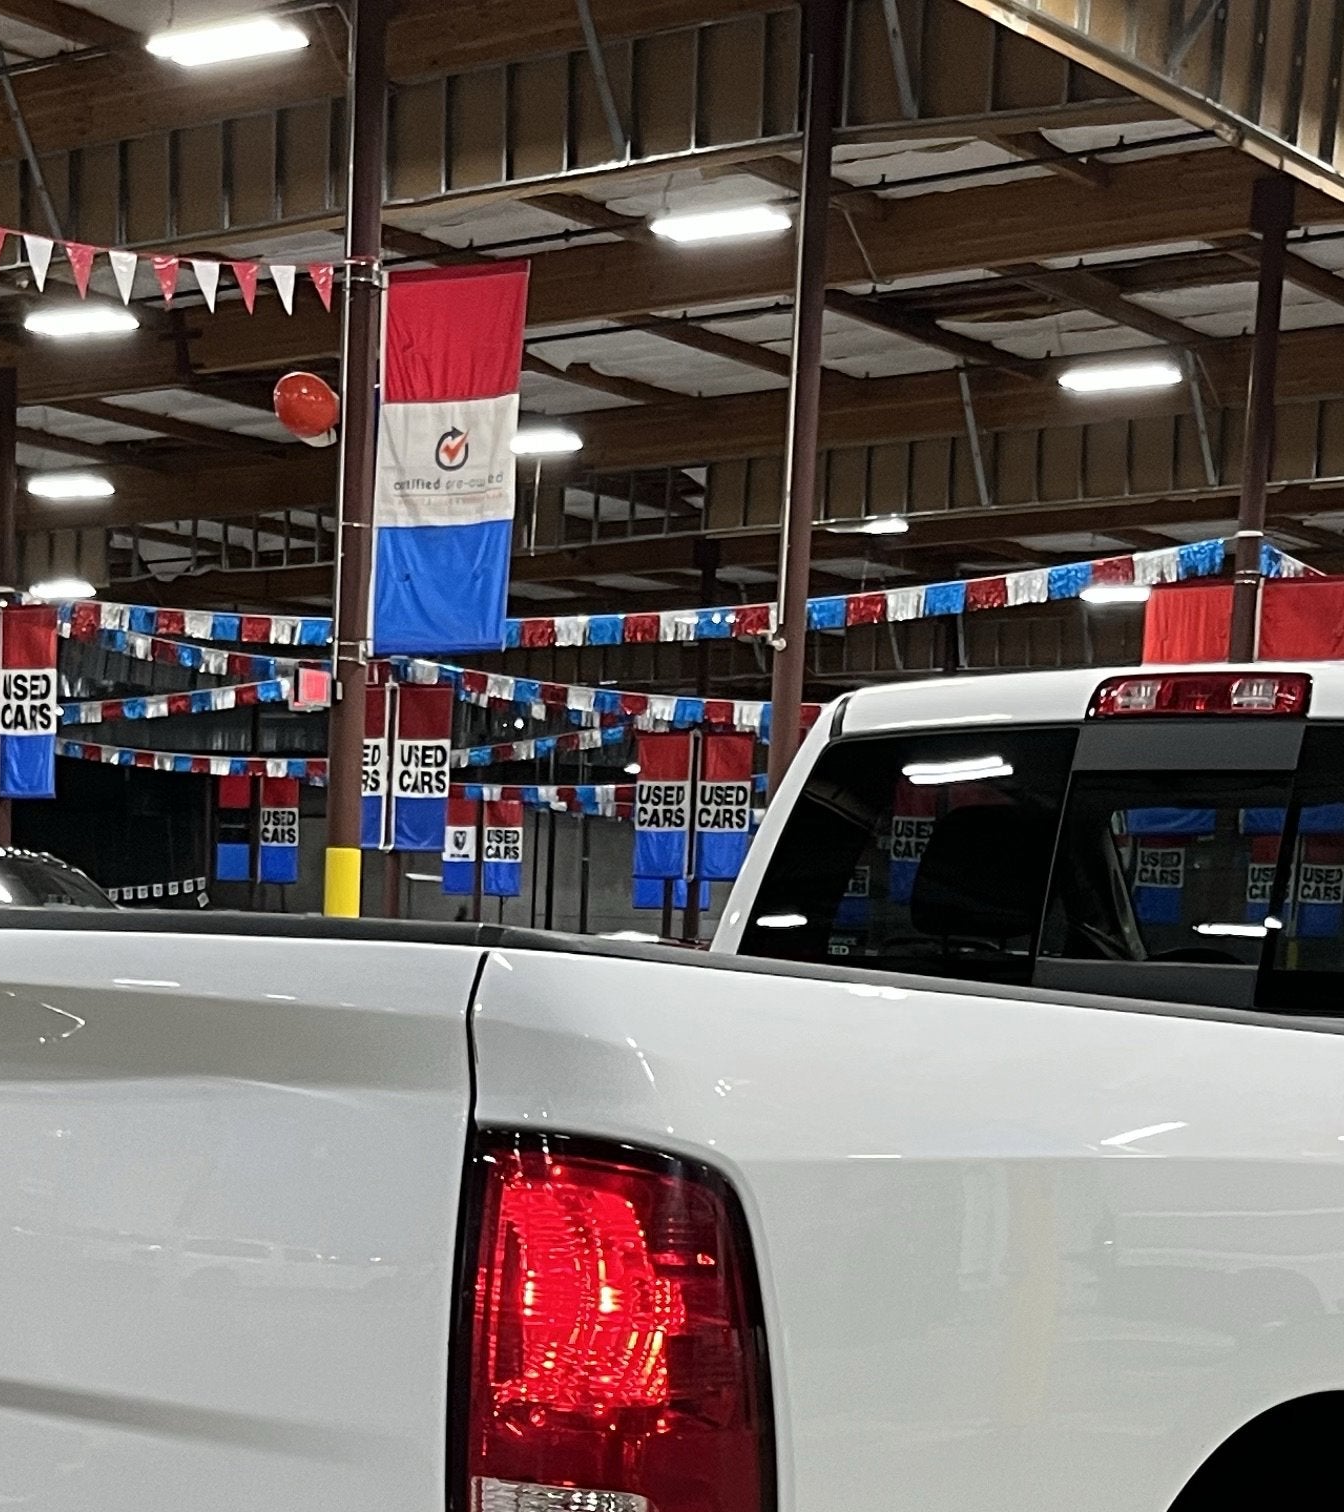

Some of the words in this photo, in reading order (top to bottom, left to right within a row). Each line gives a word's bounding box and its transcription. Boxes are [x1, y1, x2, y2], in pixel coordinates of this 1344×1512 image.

[3, 674, 51, 701] USED
[1, 703, 51, 730] CARS
[363, 745, 381, 766] ED
[400, 744, 447, 768] USED
[362, 770, 380, 792] RS
[399, 770, 447, 793] CARS
[639, 785, 685, 806] USED
[701, 785, 748, 806] USED
[638, 807, 685, 827] CARS
[698, 808, 747, 829] CARS
[486, 845, 519, 860] CARS
